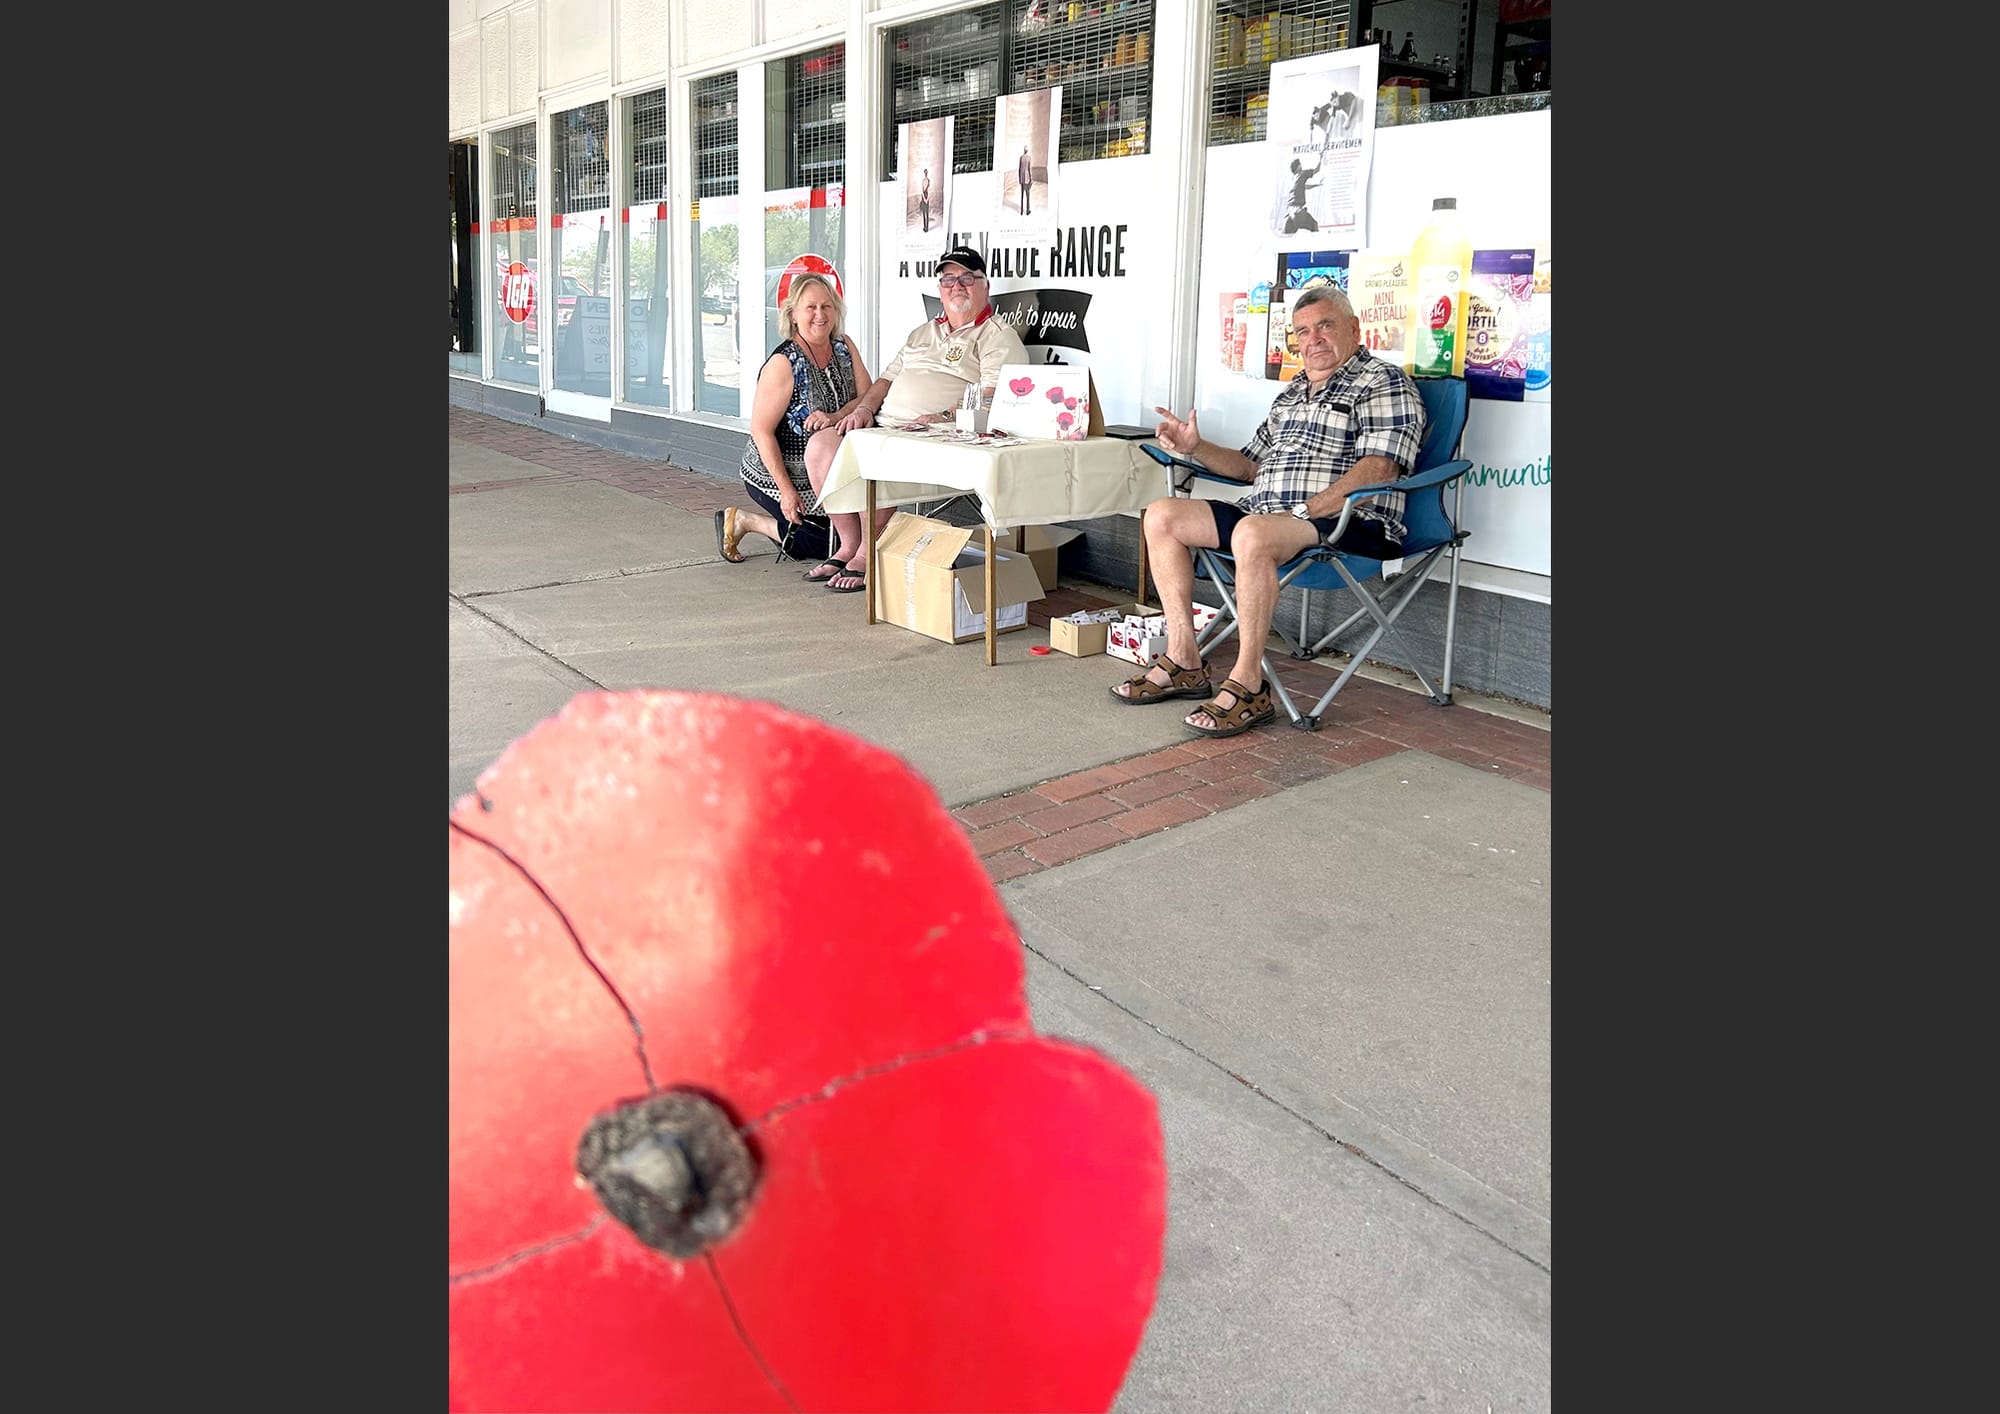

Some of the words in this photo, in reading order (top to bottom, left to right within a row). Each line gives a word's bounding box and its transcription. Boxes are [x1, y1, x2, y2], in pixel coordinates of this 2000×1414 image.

[1049, 225, 1127, 278] RANGE
[1374, 290, 1394, 306] MINI
[1026, 304, 1039, 327] to
[1039, 310, 1077, 339] your
[1479, 333, 1487, 344] 8
